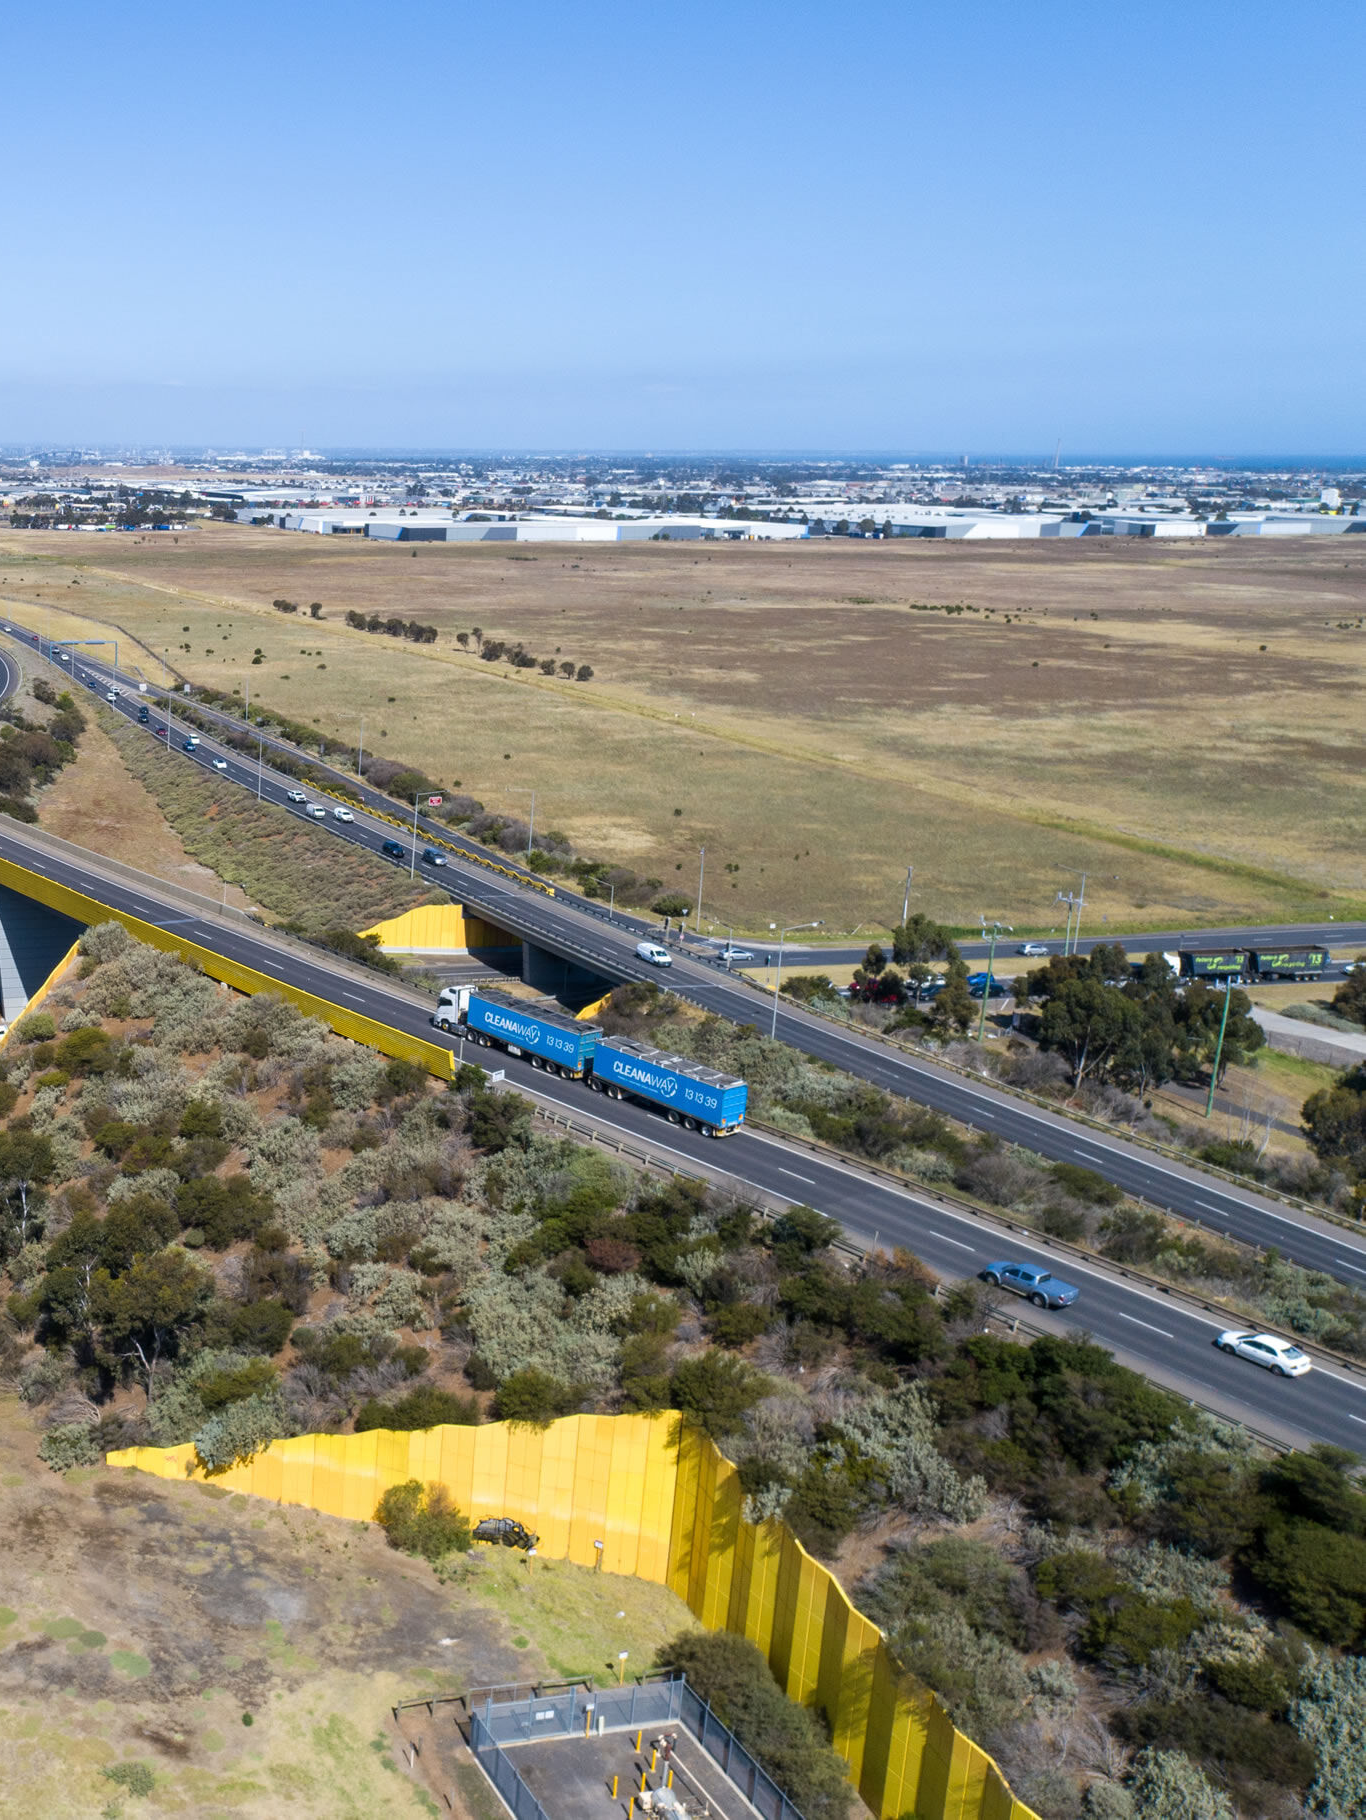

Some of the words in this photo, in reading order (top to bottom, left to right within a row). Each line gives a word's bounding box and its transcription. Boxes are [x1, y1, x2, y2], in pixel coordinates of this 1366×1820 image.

[485, 1012, 538, 1041] CLEANAWAY
[546, 1035, 554, 1046] 13
[555, 1039, 563, 1049] 13
[563, 1042, 574, 1053] 39
[613, 1061, 675, 1094] CLEANAWAY
[685, 1088, 694, 1100] 13
[695, 1092, 704, 1104] 13
[704, 1096, 718, 1109] 39
